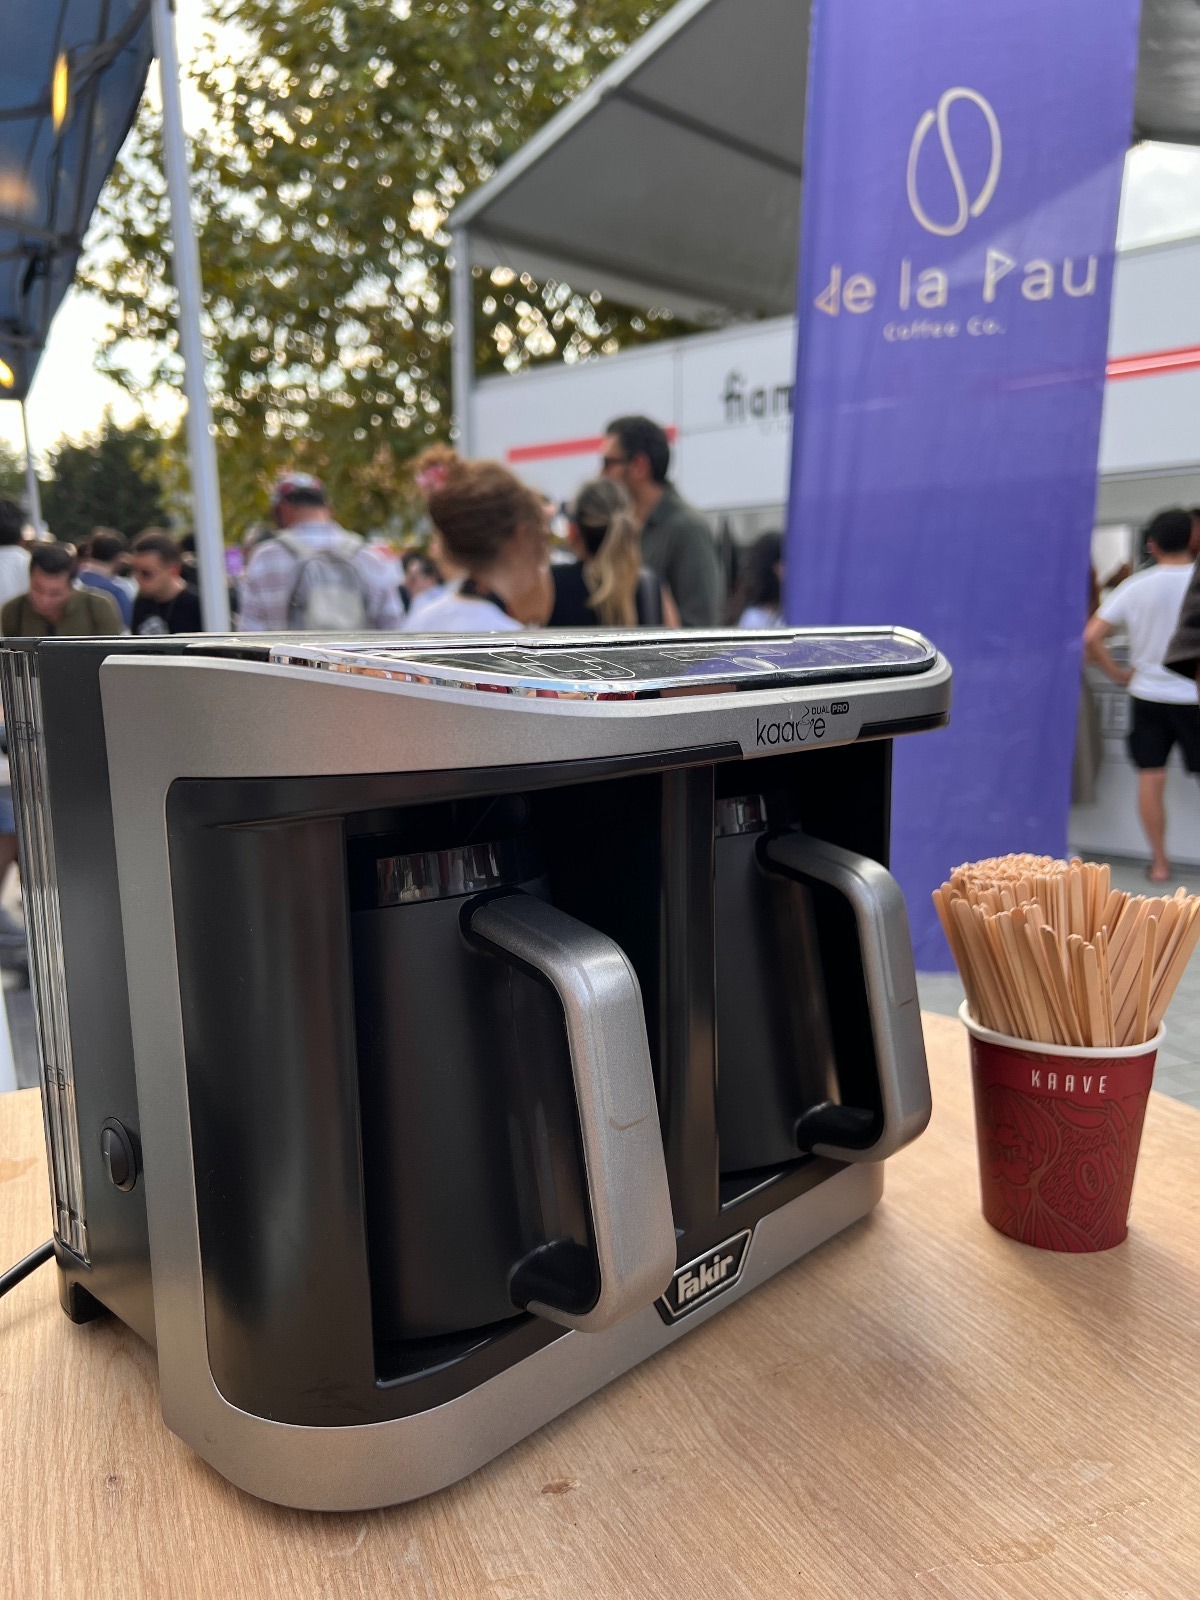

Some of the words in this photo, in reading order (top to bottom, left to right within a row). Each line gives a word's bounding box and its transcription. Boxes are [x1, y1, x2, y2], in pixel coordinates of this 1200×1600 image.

[813, 263, 876, 316] de
[899, 255, 949, 311] la
[982, 247, 1098, 304] Pau
[811, 705, 830, 715] DUAL
[831, 702, 849, 715] PRO
[1031, 1069, 1108, 1094] KAAVE
[677, 1254, 734, 1305] Fakir
